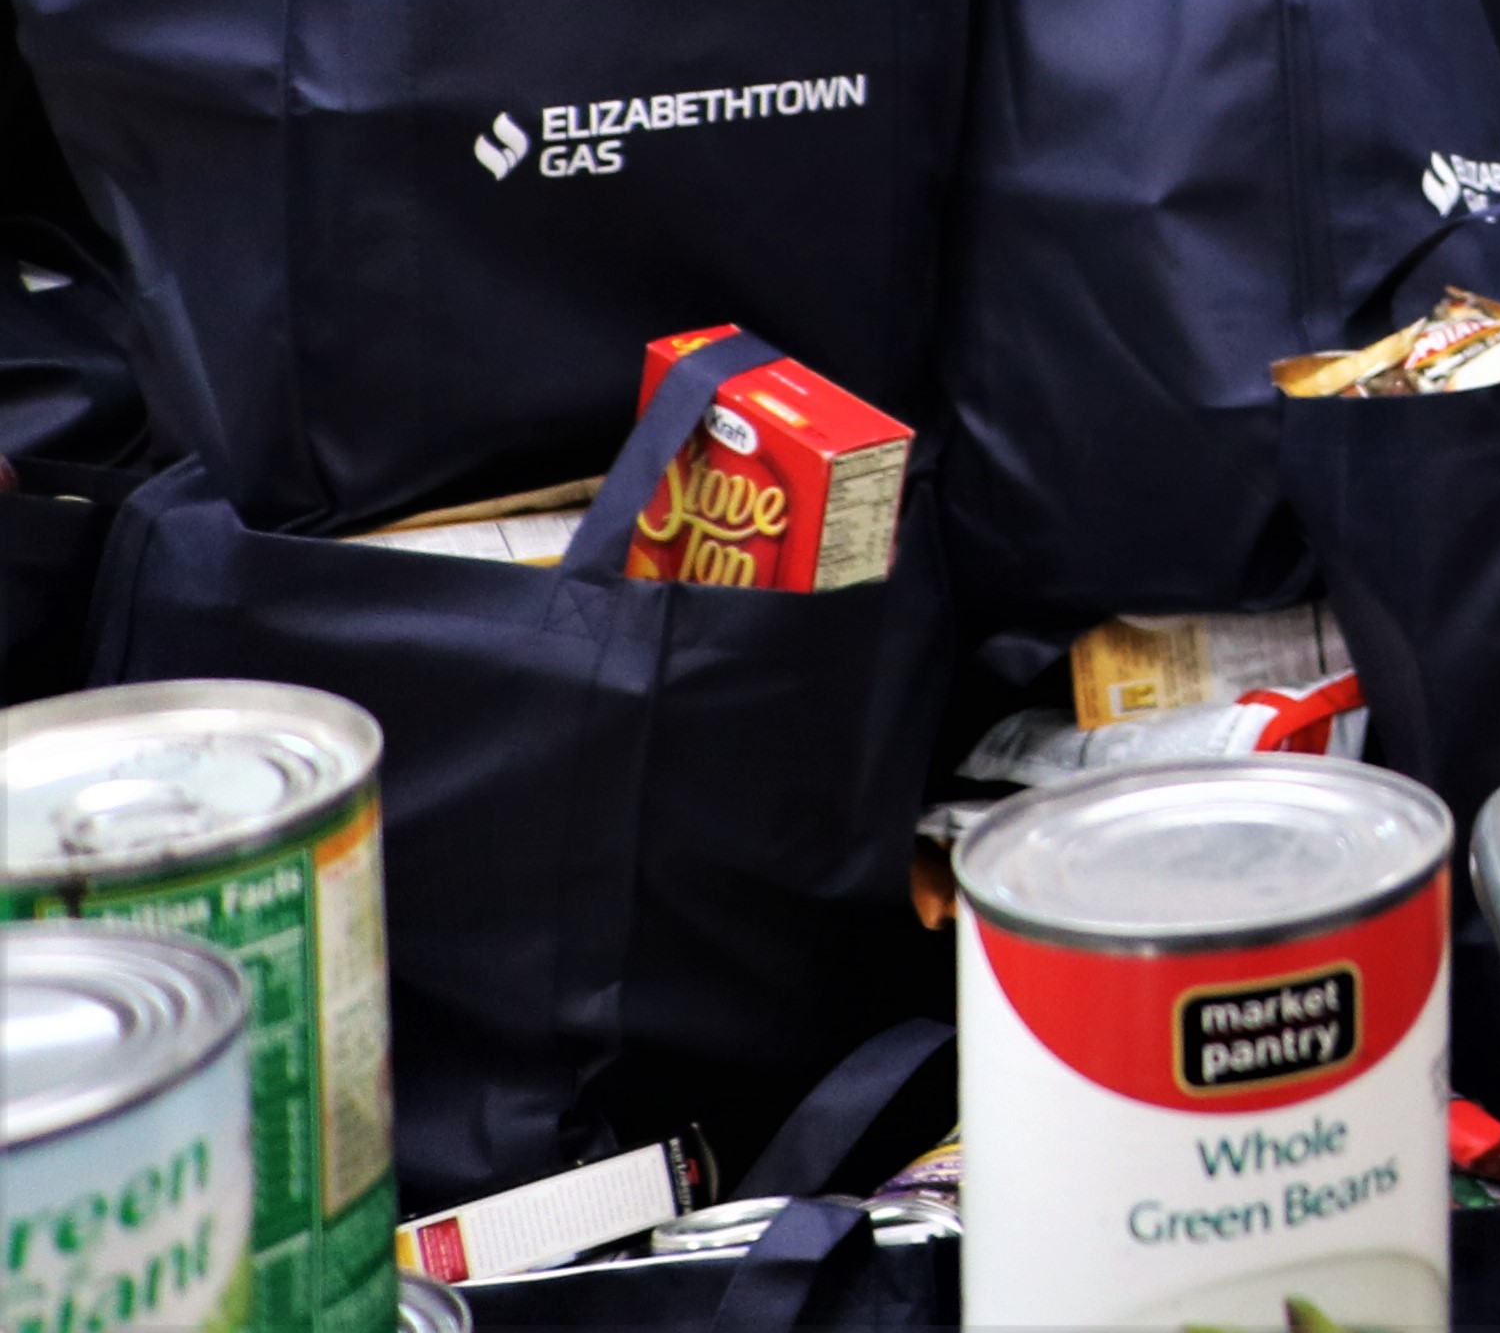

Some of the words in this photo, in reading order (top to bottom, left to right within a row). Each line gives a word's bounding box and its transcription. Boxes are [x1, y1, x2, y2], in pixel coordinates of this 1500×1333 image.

[541, 73, 868, 142] ELIZABETHTOWN
[538, 138, 625, 178] GAS
[1200, 979, 1341, 1034] market
[1201, 1020, 1341, 1083] pantry
[1197, 1114, 1348, 1178] Whole
[1128, 1198, 1272, 1245] Green
[1283, 1155, 1399, 1228] Beans
